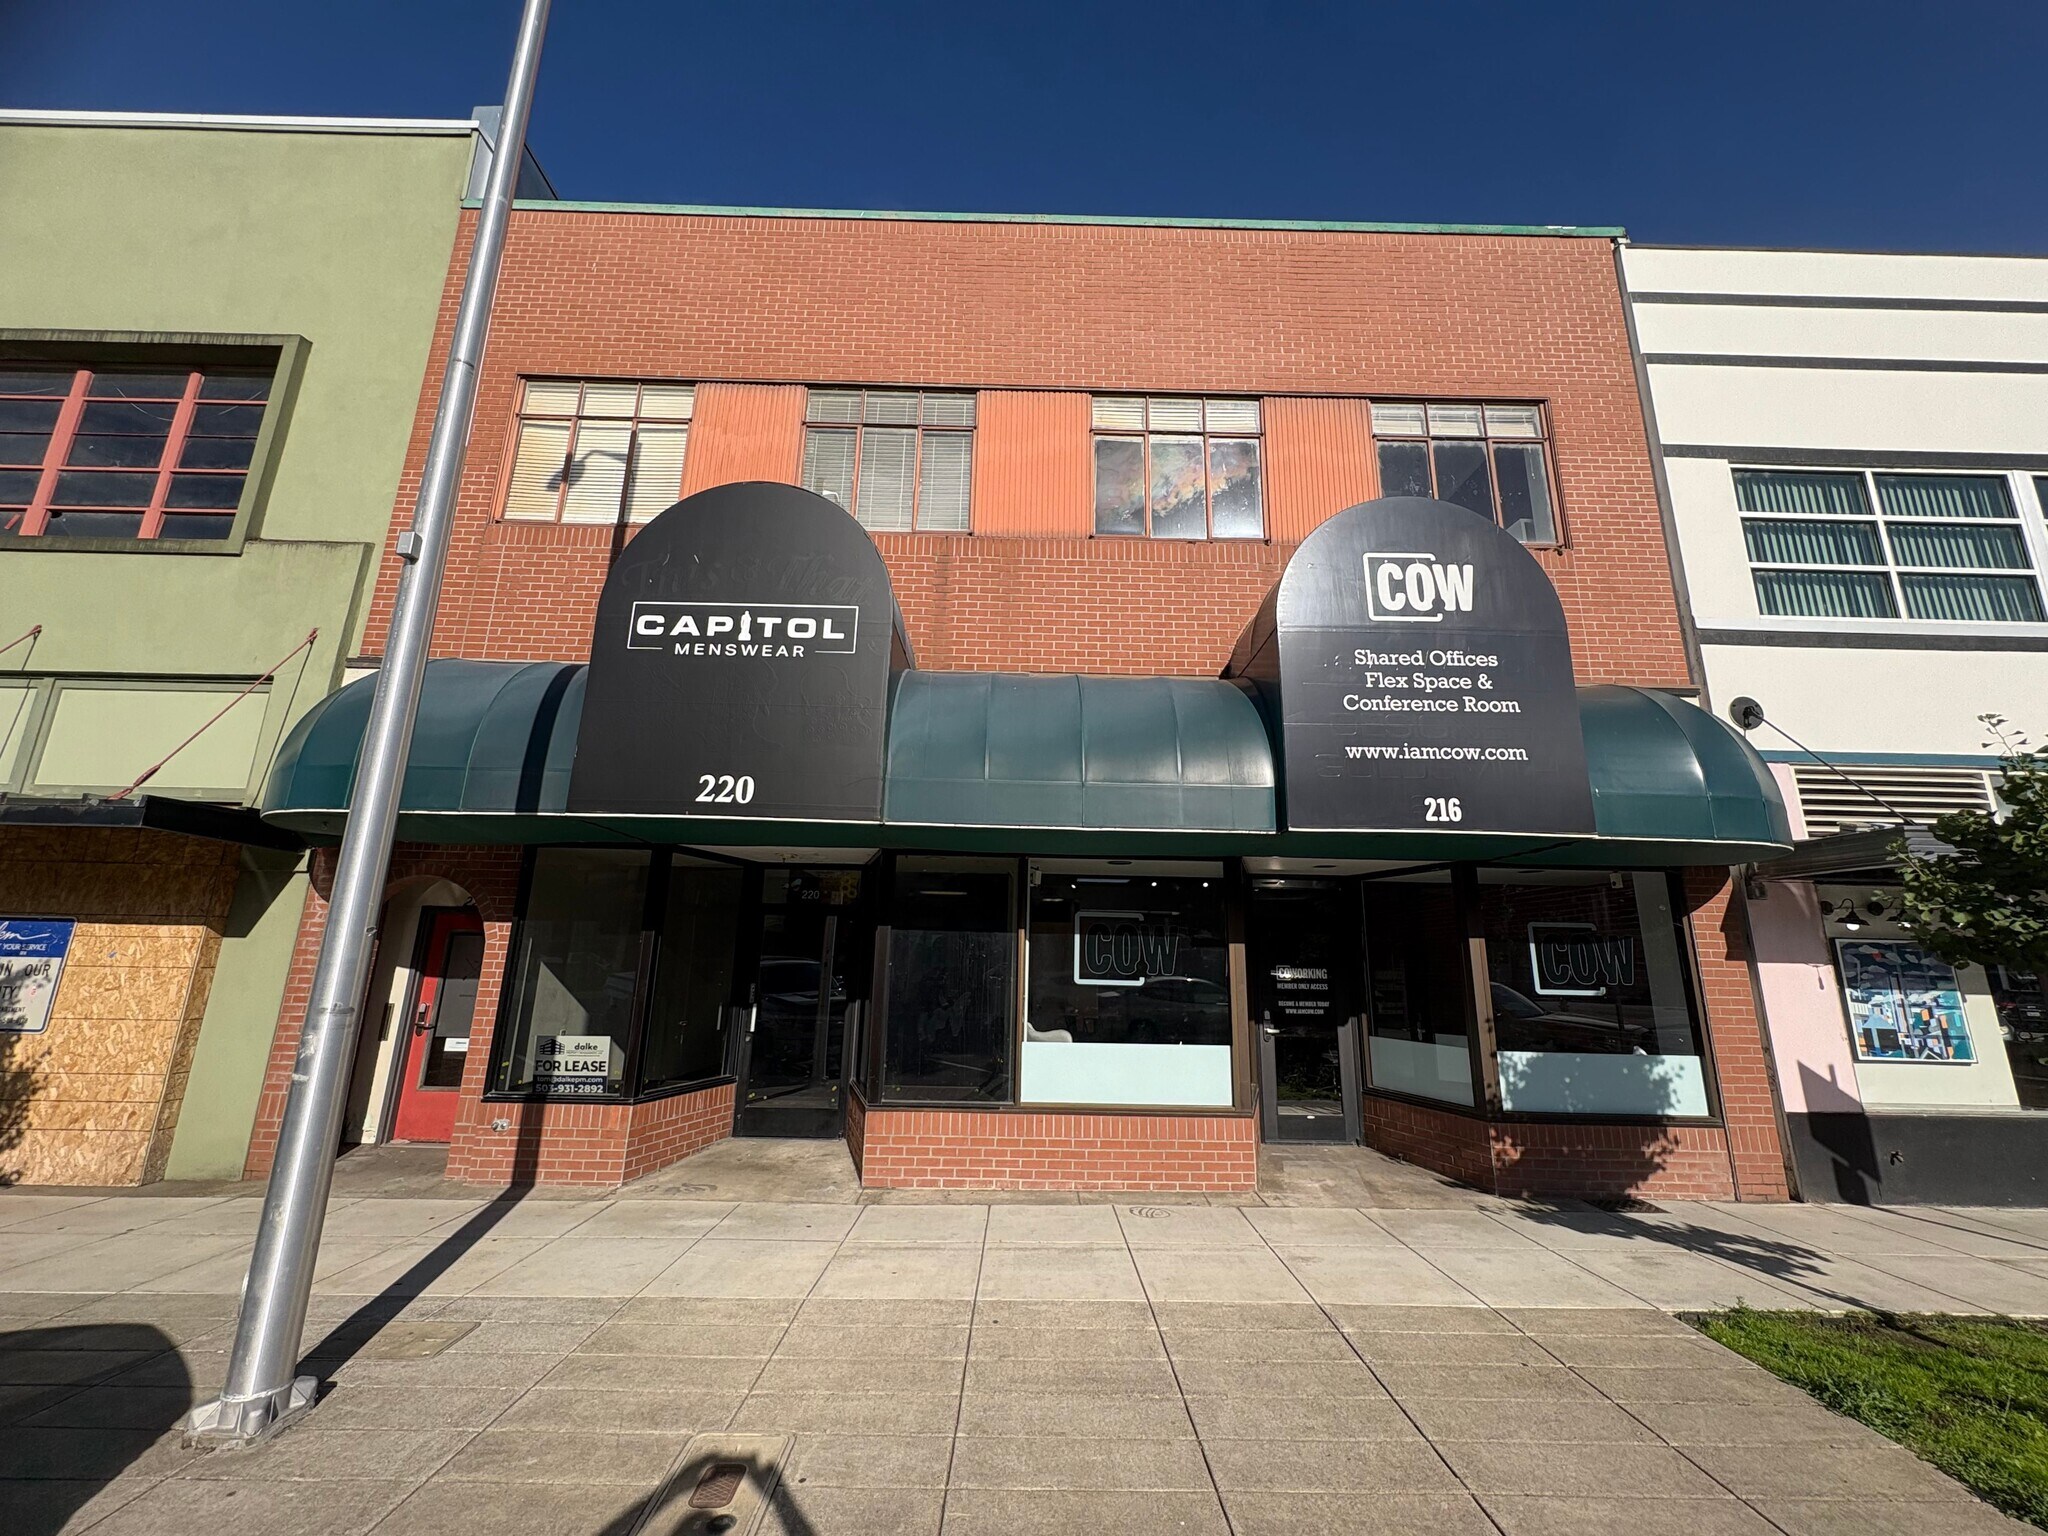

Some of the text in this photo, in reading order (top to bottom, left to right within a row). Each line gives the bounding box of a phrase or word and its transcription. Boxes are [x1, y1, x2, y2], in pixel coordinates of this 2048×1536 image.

[1376, 562, 1474, 612] COW
[636, 611, 845, 641] CAPITOL
[674, 643, 805, 658] MENSWEAR
[1354, 648, 1499, 666] Shared Offices
[1364, 671, 1494, 692] Flex Space &
[1343, 694, 1521, 713] Conference Room
[1344, 743, 1529, 761] www.iamcow.com
[695, 774, 755, 804] 220
[1424, 797, 1462, 822] 216
[801, 889, 820, 900] 220
[3, 942, 47, 951] YOUR SERVICE
[1084, 922, 1180, 976] COW
[1540, 932, 1635, 986] COW
[24, 963, 52, 977] OUR
[1279, 968, 1328, 980] COWORKING
[1276, 982, 1297, 990] MEMBER
[1310, 983, 1328, 991] ACCESS
[573, 1042, 598, 1051] dalke
[535, 1059, 606, 1072] FOR LEASE
[537, 1076, 603, 1084] tom@dalkepm.com
[535, 1084, 604, 1093] 503-931-2892
